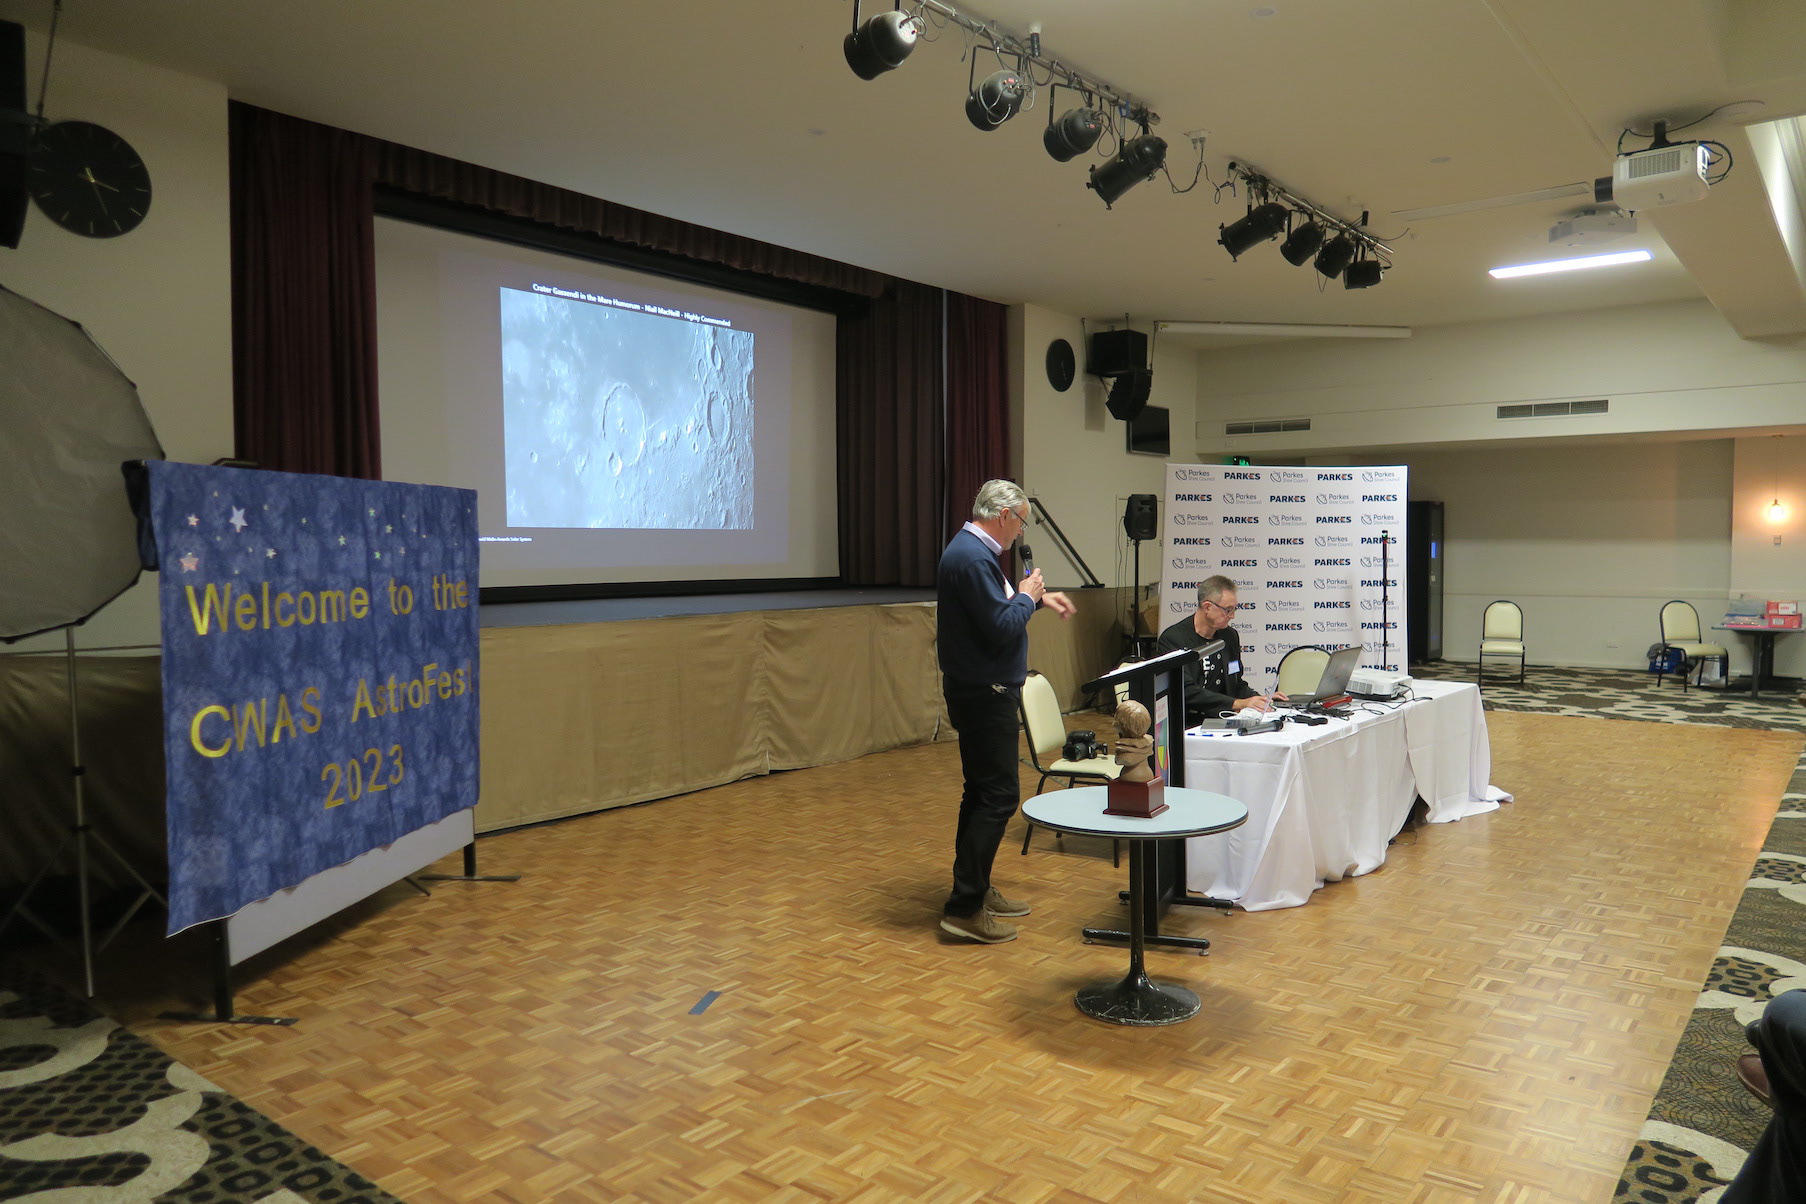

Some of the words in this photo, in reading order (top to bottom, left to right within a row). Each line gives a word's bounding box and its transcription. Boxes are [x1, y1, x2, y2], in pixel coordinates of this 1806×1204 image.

[186, 582, 369, 636] Welcome
[388, 578, 414, 616] to
[432, 573, 469, 611] the
[190, 686, 323, 758] CWAS
[320, 744, 404, 810] 2023
